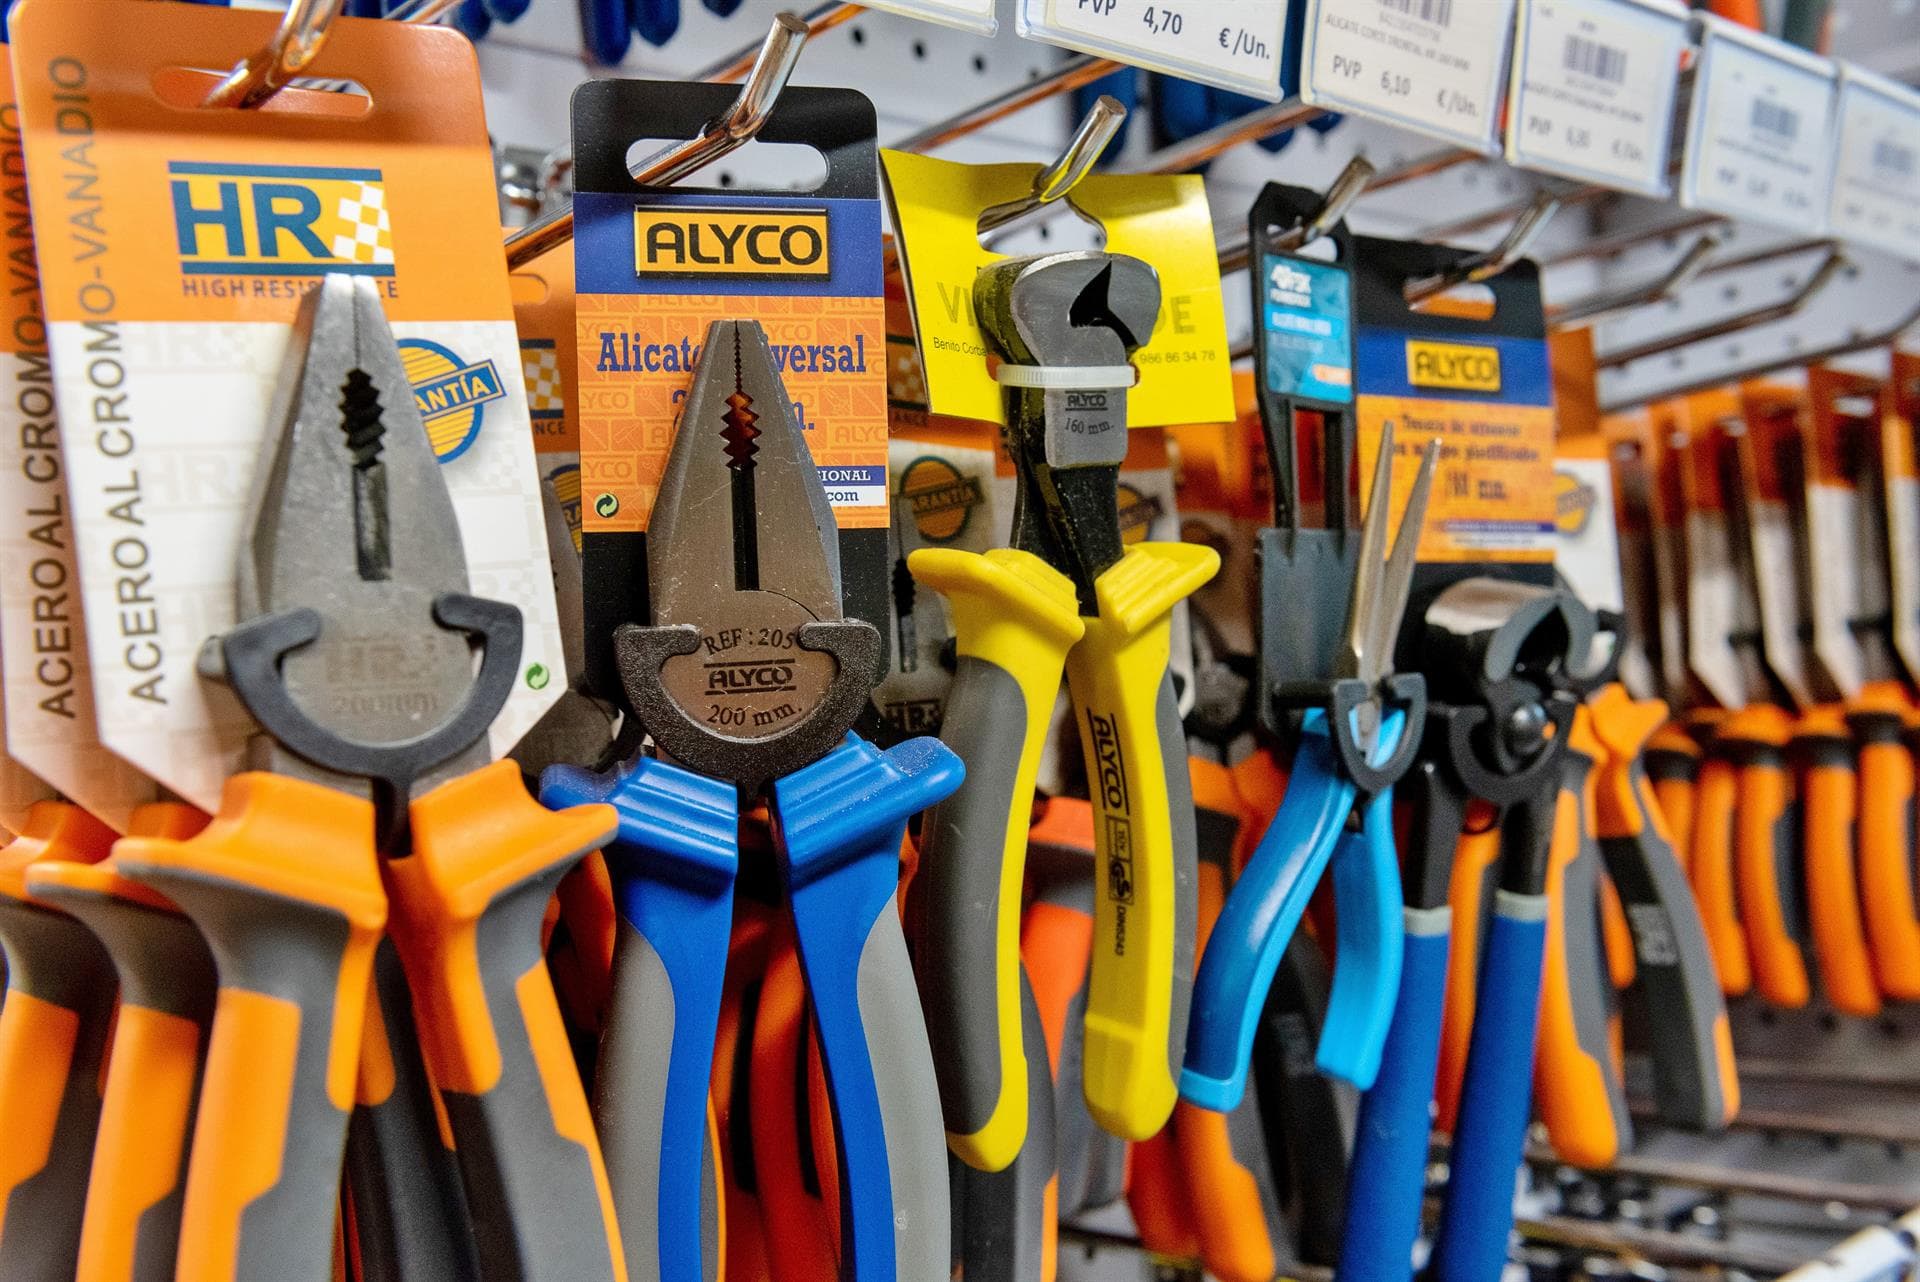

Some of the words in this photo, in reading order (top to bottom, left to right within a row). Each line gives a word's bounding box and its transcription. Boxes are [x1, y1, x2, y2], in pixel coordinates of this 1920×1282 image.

[1143, 6, 1182, 35] 4,70
[1332, 55, 1362, 79] PVP
[1381, 70, 1411, 97] 6,10
[171, 180, 337, 259] HR
[48, 56, 135, 458] CROMO-VANADIO
[646, 222, 823, 266] ALYCO
[182, 278, 246, 297] HIGH
[596, 332, 701, 373] Alicat
[770, 334, 867, 373] versal
[1415, 350, 1499, 383] ALYCO
[415, 374, 492, 414] ANTÍA
[1068, 393, 1107, 408] ALYCO
[1064, 417, 1085, 434] 160
[102, 469, 146, 526] AL
[25, 494, 66, 549] AL
[30, 557, 76, 719] ACERO
[111, 537, 168, 705] ACERO
[708, 666, 793, 689] ALYCO
[706, 703, 746, 726] 200
[752, 703, 803, 727] mm.
[1092, 714, 1124, 811] ALYCO
